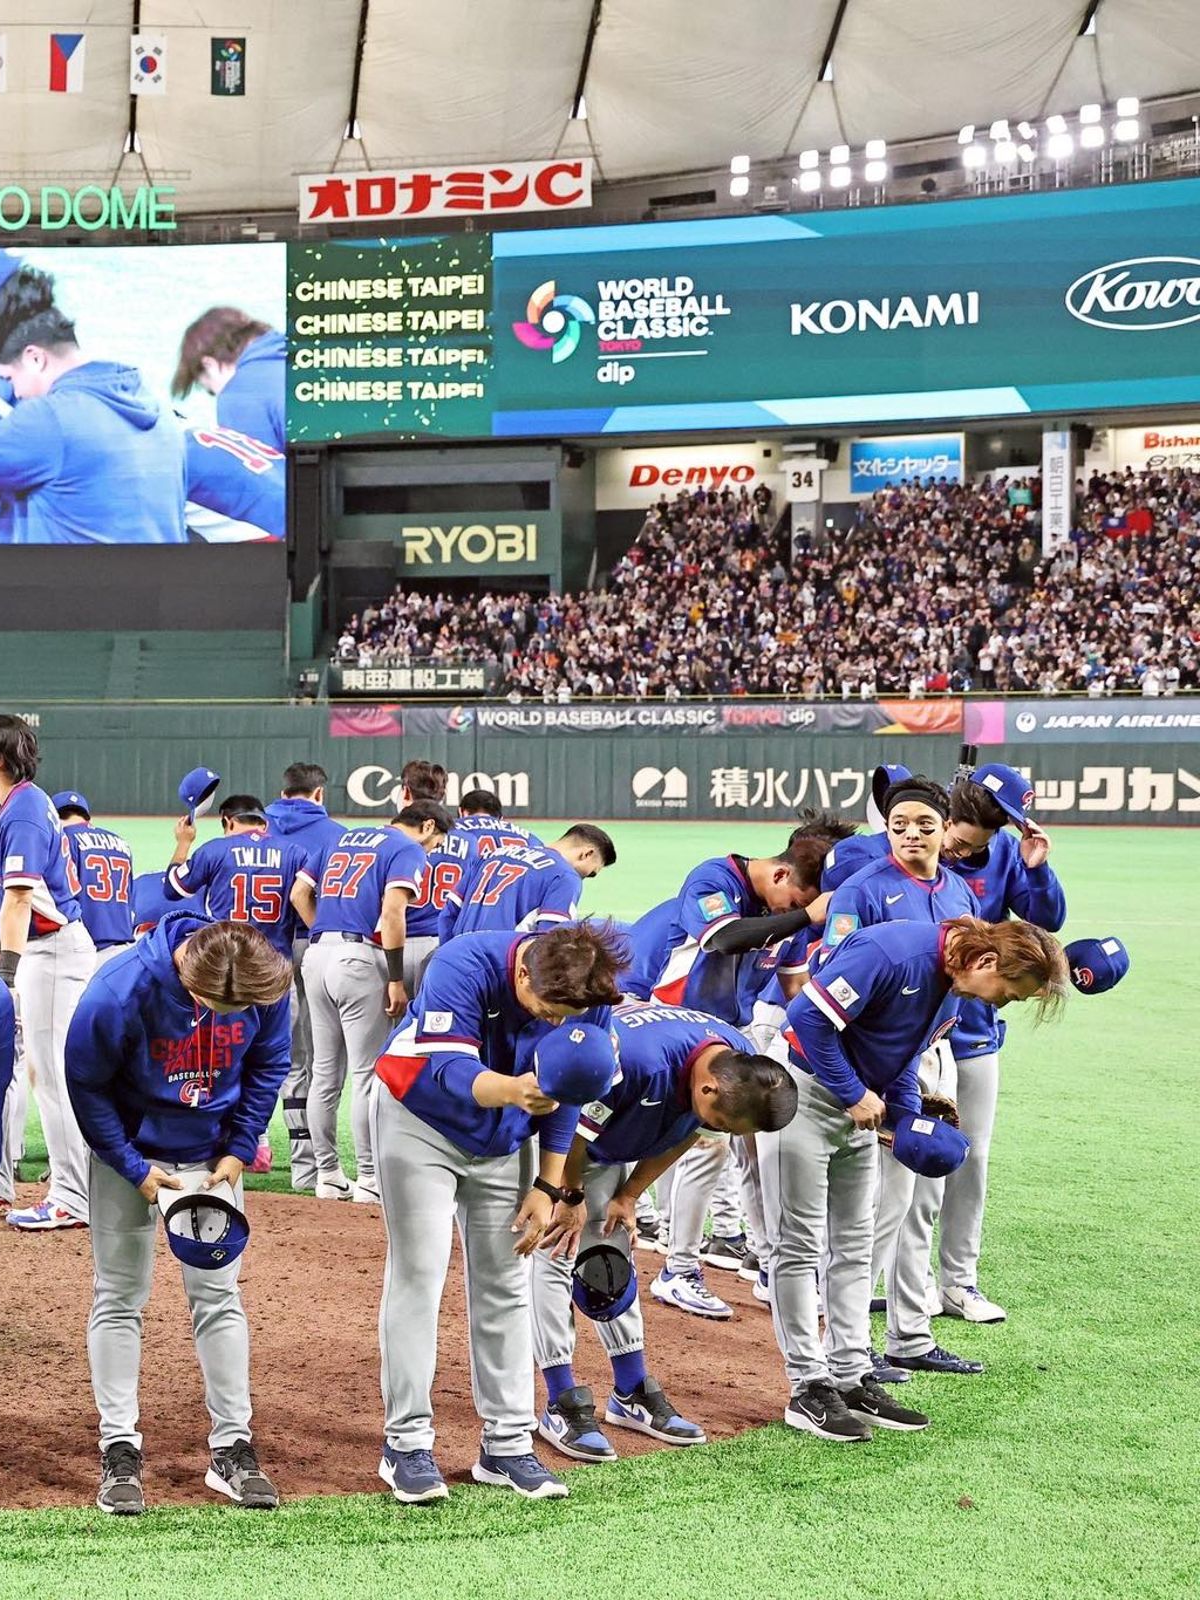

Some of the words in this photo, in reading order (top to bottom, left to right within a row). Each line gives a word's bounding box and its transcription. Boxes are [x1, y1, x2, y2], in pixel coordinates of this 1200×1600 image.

[308, 162, 584, 219] オロナミンC
[40, 185, 177, 231] DOME
[295, 277, 403, 301] CHINESE
[407, 274, 484, 297] TAIPEI
[598, 276, 694, 301] WORLD
[599, 294, 732, 321] BASEBALL
[791, 291, 979, 335] KONAMI
[295, 311, 403, 335] CHINESE
[407, 309, 484, 331] TAIPEI
[295, 346, 403, 369] CHINESE
[597, 361, 635, 386] dip
[295, 381, 403, 402] CHINESE
[629, 464, 756, 490] Denyo
[792, 471, 814, 489] 34
[402, 524, 537, 564] RYOBI
[477, 709, 541, 727] WORLD
[545, 709, 636, 726] BASEBALL
[637, 709, 716, 726] CLASSIC
[723, 709, 781, 726] TOKYO
[789, 707, 816, 726] dip
[1043, 714, 1114, 729] JAPAN
[709, 766, 873, 808] 積水ハウ
[231, 847, 282, 869] T.W.LIN
[85, 854, 132, 903] 37
[321, 852, 377, 898] 27
[470, 860, 528, 906] 17
[230, 873, 282, 924] 15
[168, 1070, 211, 1084] BASEBALL
